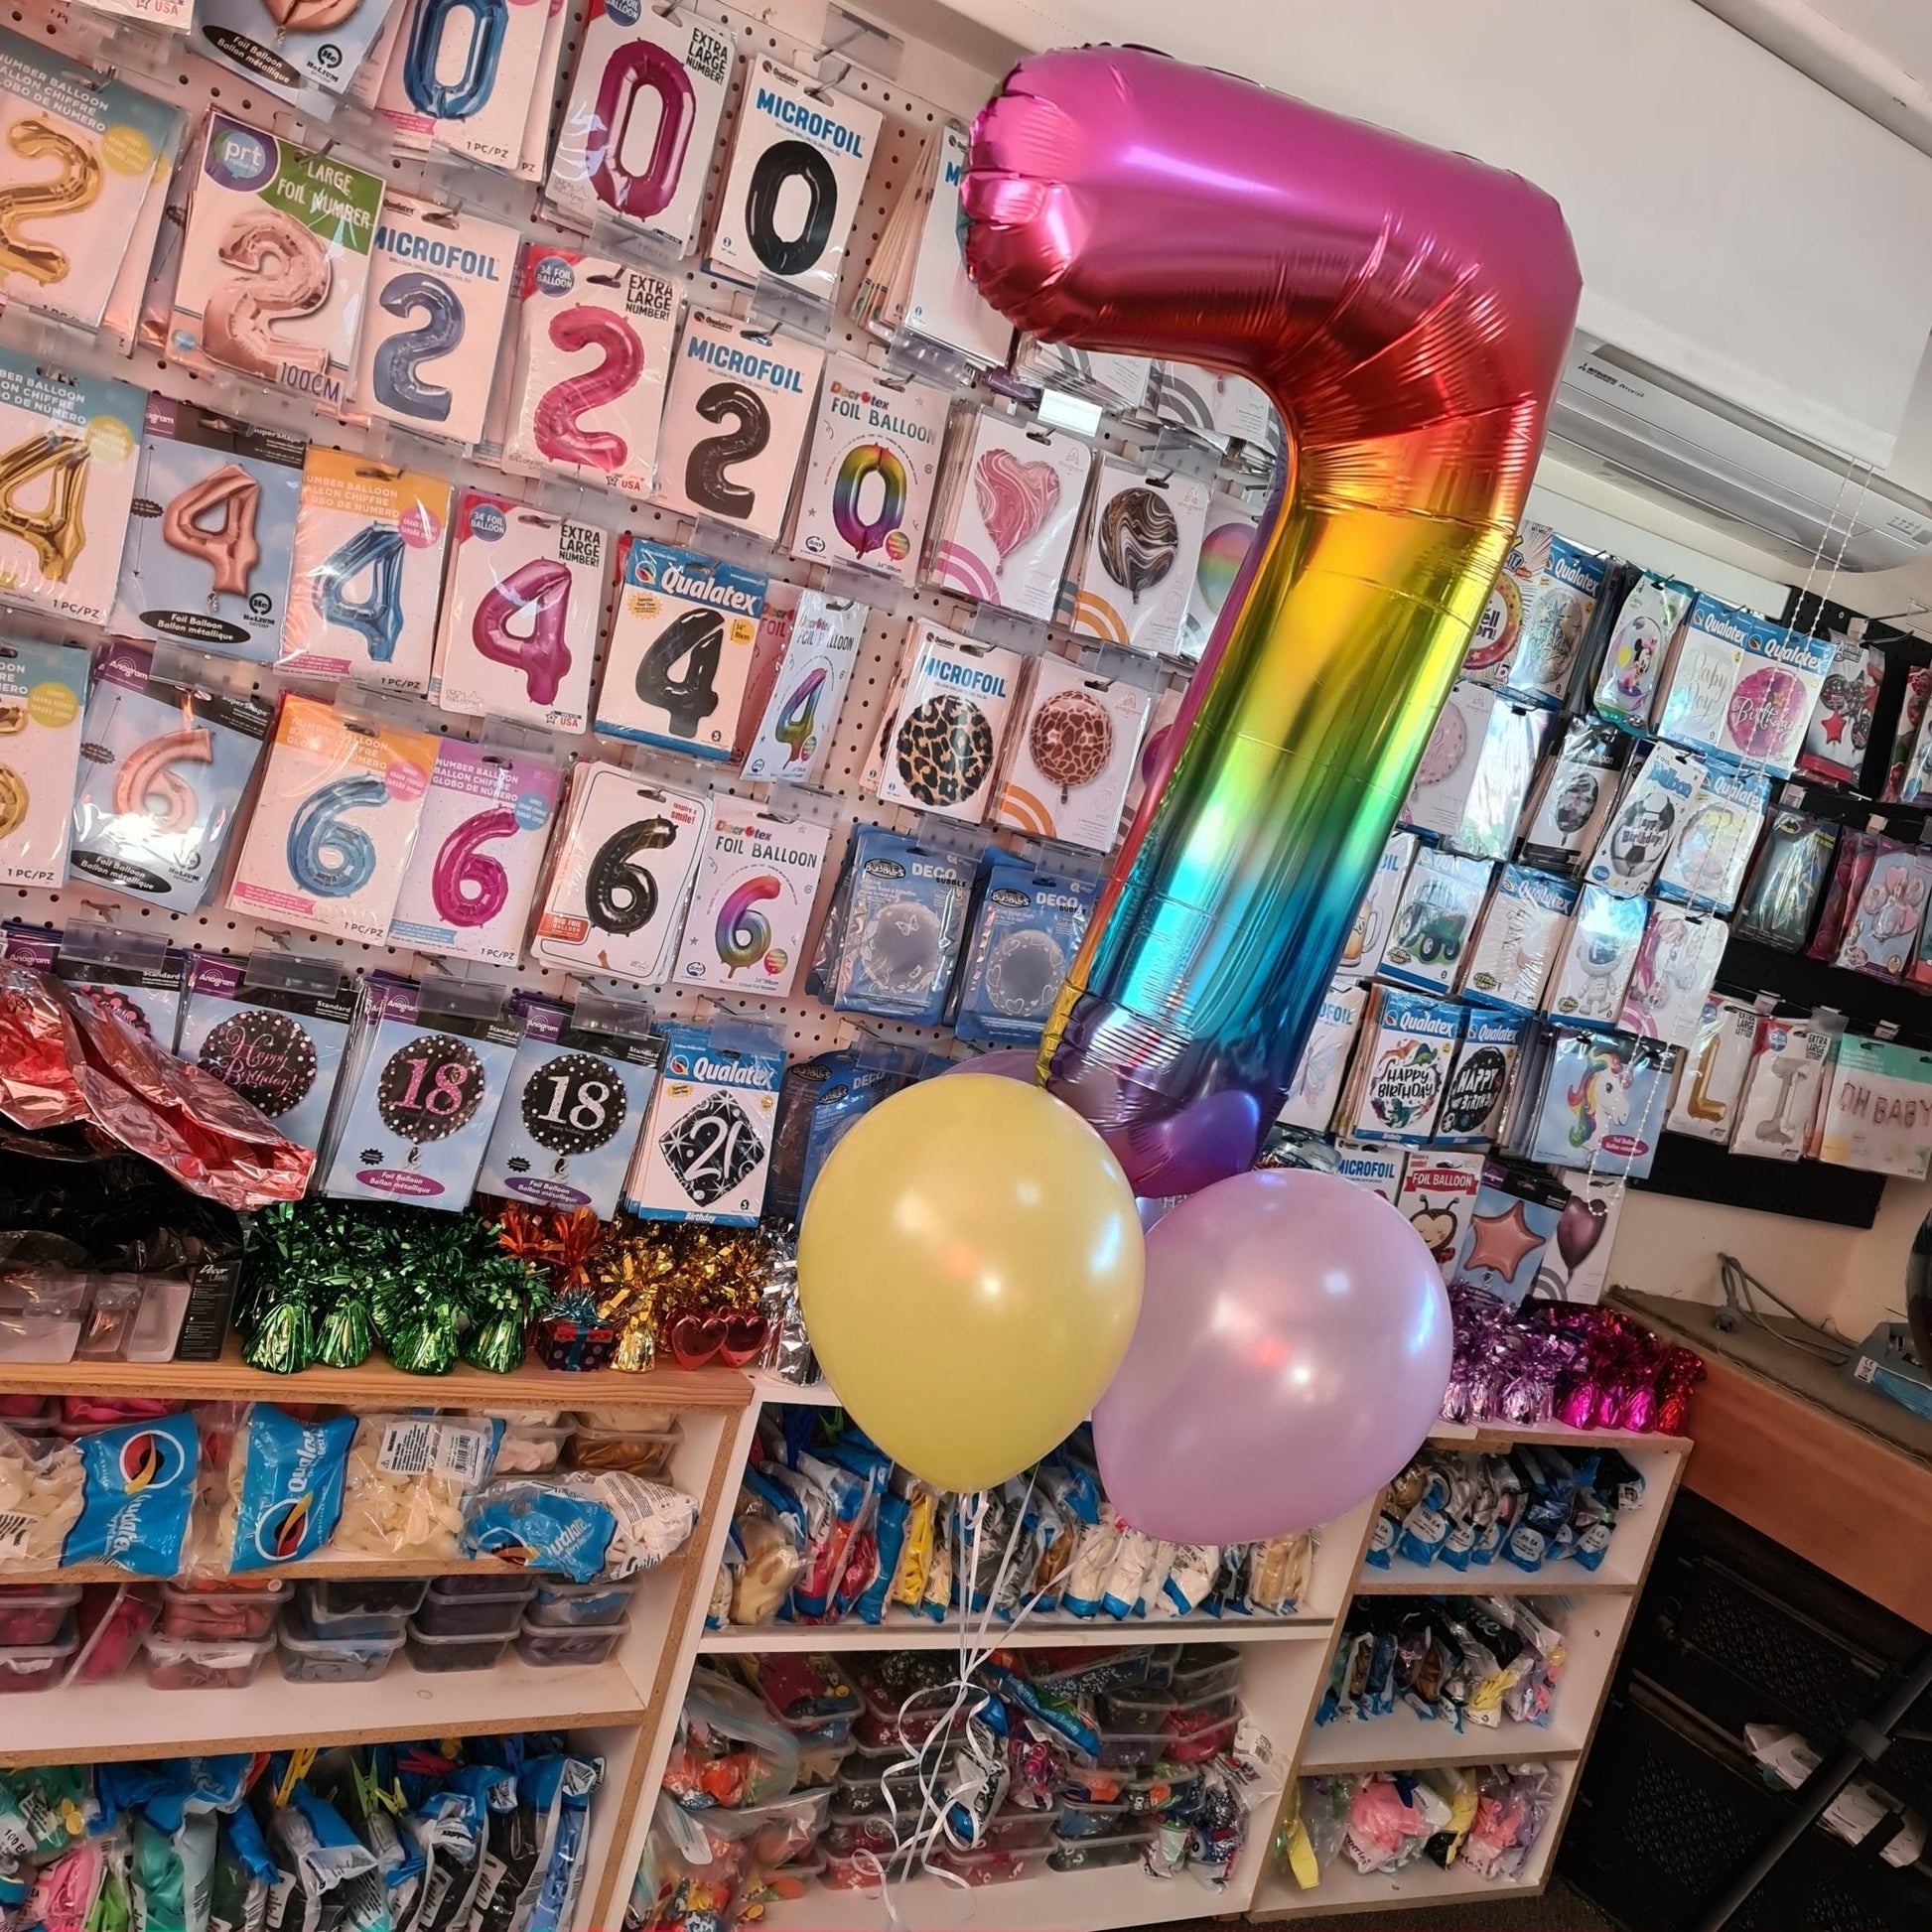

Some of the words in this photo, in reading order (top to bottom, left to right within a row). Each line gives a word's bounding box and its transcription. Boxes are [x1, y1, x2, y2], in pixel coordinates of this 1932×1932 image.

[155, 3, 178, 16] USA
[692, 27, 728, 61] EXTRA
[217, 38, 244, 58] Ballon
[246, 55, 290, 83] métallique
[233, 37, 249, 50] Foil
[250, 45, 283, 69] Balloon
[689, 44, 726, 75] LARGE
[686, 60, 724, 84] NUMBER!
[34, 92, 49, 109] DE
[45, 87, 96, 115] CHIFFRE
[51, 78, 108, 111] BALLOON
[757, 88, 864, 159] MICROFOIL
[224, 141, 262, 167] prt
[474, 143, 508, 160] PC/PZ
[307, 162, 353, 197] LARGE
[277, 179, 307, 204] FOIL
[537, 273, 573, 289] BALLOON
[554, 267, 572, 281] FOIL
[629, 274, 673, 298] EXTRA
[626, 287, 672, 311] LARGE
[624, 303, 670, 322] NUMBER!
[687, 336, 803, 394] MICROFOIL
[27, 377, 85, 402] BALLOON
[280, 361, 340, 402] 100CM
[15, 397, 31, 410] DE
[23, 388, 74, 410] CHIFFRE
[831, 396, 861, 421] FOIL
[869, 409, 937, 446] BALLOON
[347, 483, 398, 497] BALLOON
[621, 479, 640, 490] USA
[338, 499, 351, 509] DE
[345, 490, 389, 506] CHIFFRE
[471, 519, 504, 534] BALLOON
[487, 514, 503, 525] FOIL
[561, 524, 601, 544] EXTRA
[559, 537, 600, 558] LARGE
[559, 549, 600, 567] NUMBER!
[1554, 558, 1597, 595] Qualatex
[661, 564, 759, 616] Qualatex
[61, 602, 99, 618] PC/PZ
[171, 614, 194, 624] Foil
[196, 618, 222, 629] Balloon
[760, 617, 786, 637] FOIL
[1705, 614, 1747, 646] Qualatex
[158, 620, 186, 632] Ballon
[188, 624, 233, 641] métallique
[1765, 639, 1824, 670] Qualatex
[109, 660, 148, 680] Anagram
[920, 655, 1007, 698] MICROFOIL
[387, 678, 421, 690] PC/PZ
[560, 715, 578, 728] USA
[434, 766, 471, 783] BALLON
[436, 758, 473, 775] NUMBER
[432, 776, 465, 791] GLOBO
[468, 783, 483, 793] DE
[1714, 776, 1761, 809] Qualatex
[670, 810, 695, 825] smile!
[716, 836, 744, 855] FOIL
[752, 842, 818, 869] BALLOON
[16, 870, 54, 881] PC/PZ
[80, 860, 108, 875] Ballon
[110, 871, 155, 891] métallique
[95, 857, 112, 867] Foil
[114, 861, 146, 879] Balloon
[911, 863, 956, 881] DECO
[935, 877, 967, 888] BUBBLE
[1035, 892, 1078, 907] DECO
[351, 922, 383, 938] PC/PZ
[10, 953, 50, 966] Anagram
[487, 948, 515, 961] PC/PZ
[143, 970, 181, 981] Standard
[199, 973, 235, 989] Anagram
[317, 1001, 350, 1014] Standard
[488, 1025, 520, 1037] Standard
[526, 1019, 558, 1033] Anagram
[1400, 1013, 1453, 1037] Qualatex
[1478, 1024, 1519, 1042] Qualatex
[1737, 1020, 1755, 1032] LARGE
[1806, 1041, 1826, 1054] LARGE
[1809, 1035, 1828, 1045] EXTRA
[629, 1045, 659, 1058] Standard
[694, 1056, 775, 1092] Qualatex
[852, 1072, 885, 1089] DECO
[1388, 1068, 1429, 1084] HAPPY
[1457, 1068, 1497, 1092] HAPPY
[392, 1057, 468, 1115] 18
[1378, 1082, 1434, 1099] BIRTHDAY
[538, 1075, 611, 1131] 18
[684, 1116, 744, 1182] 21
[369, 1178, 392, 1188] Ballon
[393, 1181, 430, 1194] métallique
[382, 1171, 395, 1179] Foil
[396, 1173, 423, 1185] Balloon
[1412, 1173, 1432, 1186] FOIL
[1433, 1173, 1472, 1188] BALLOON
[518, 1184, 541, 1194] Ballon
[542, 1188, 579, 1203] métallique
[545, 1181, 570, 1194] Balloon
[684, 1211, 716, 1223] Birthday
